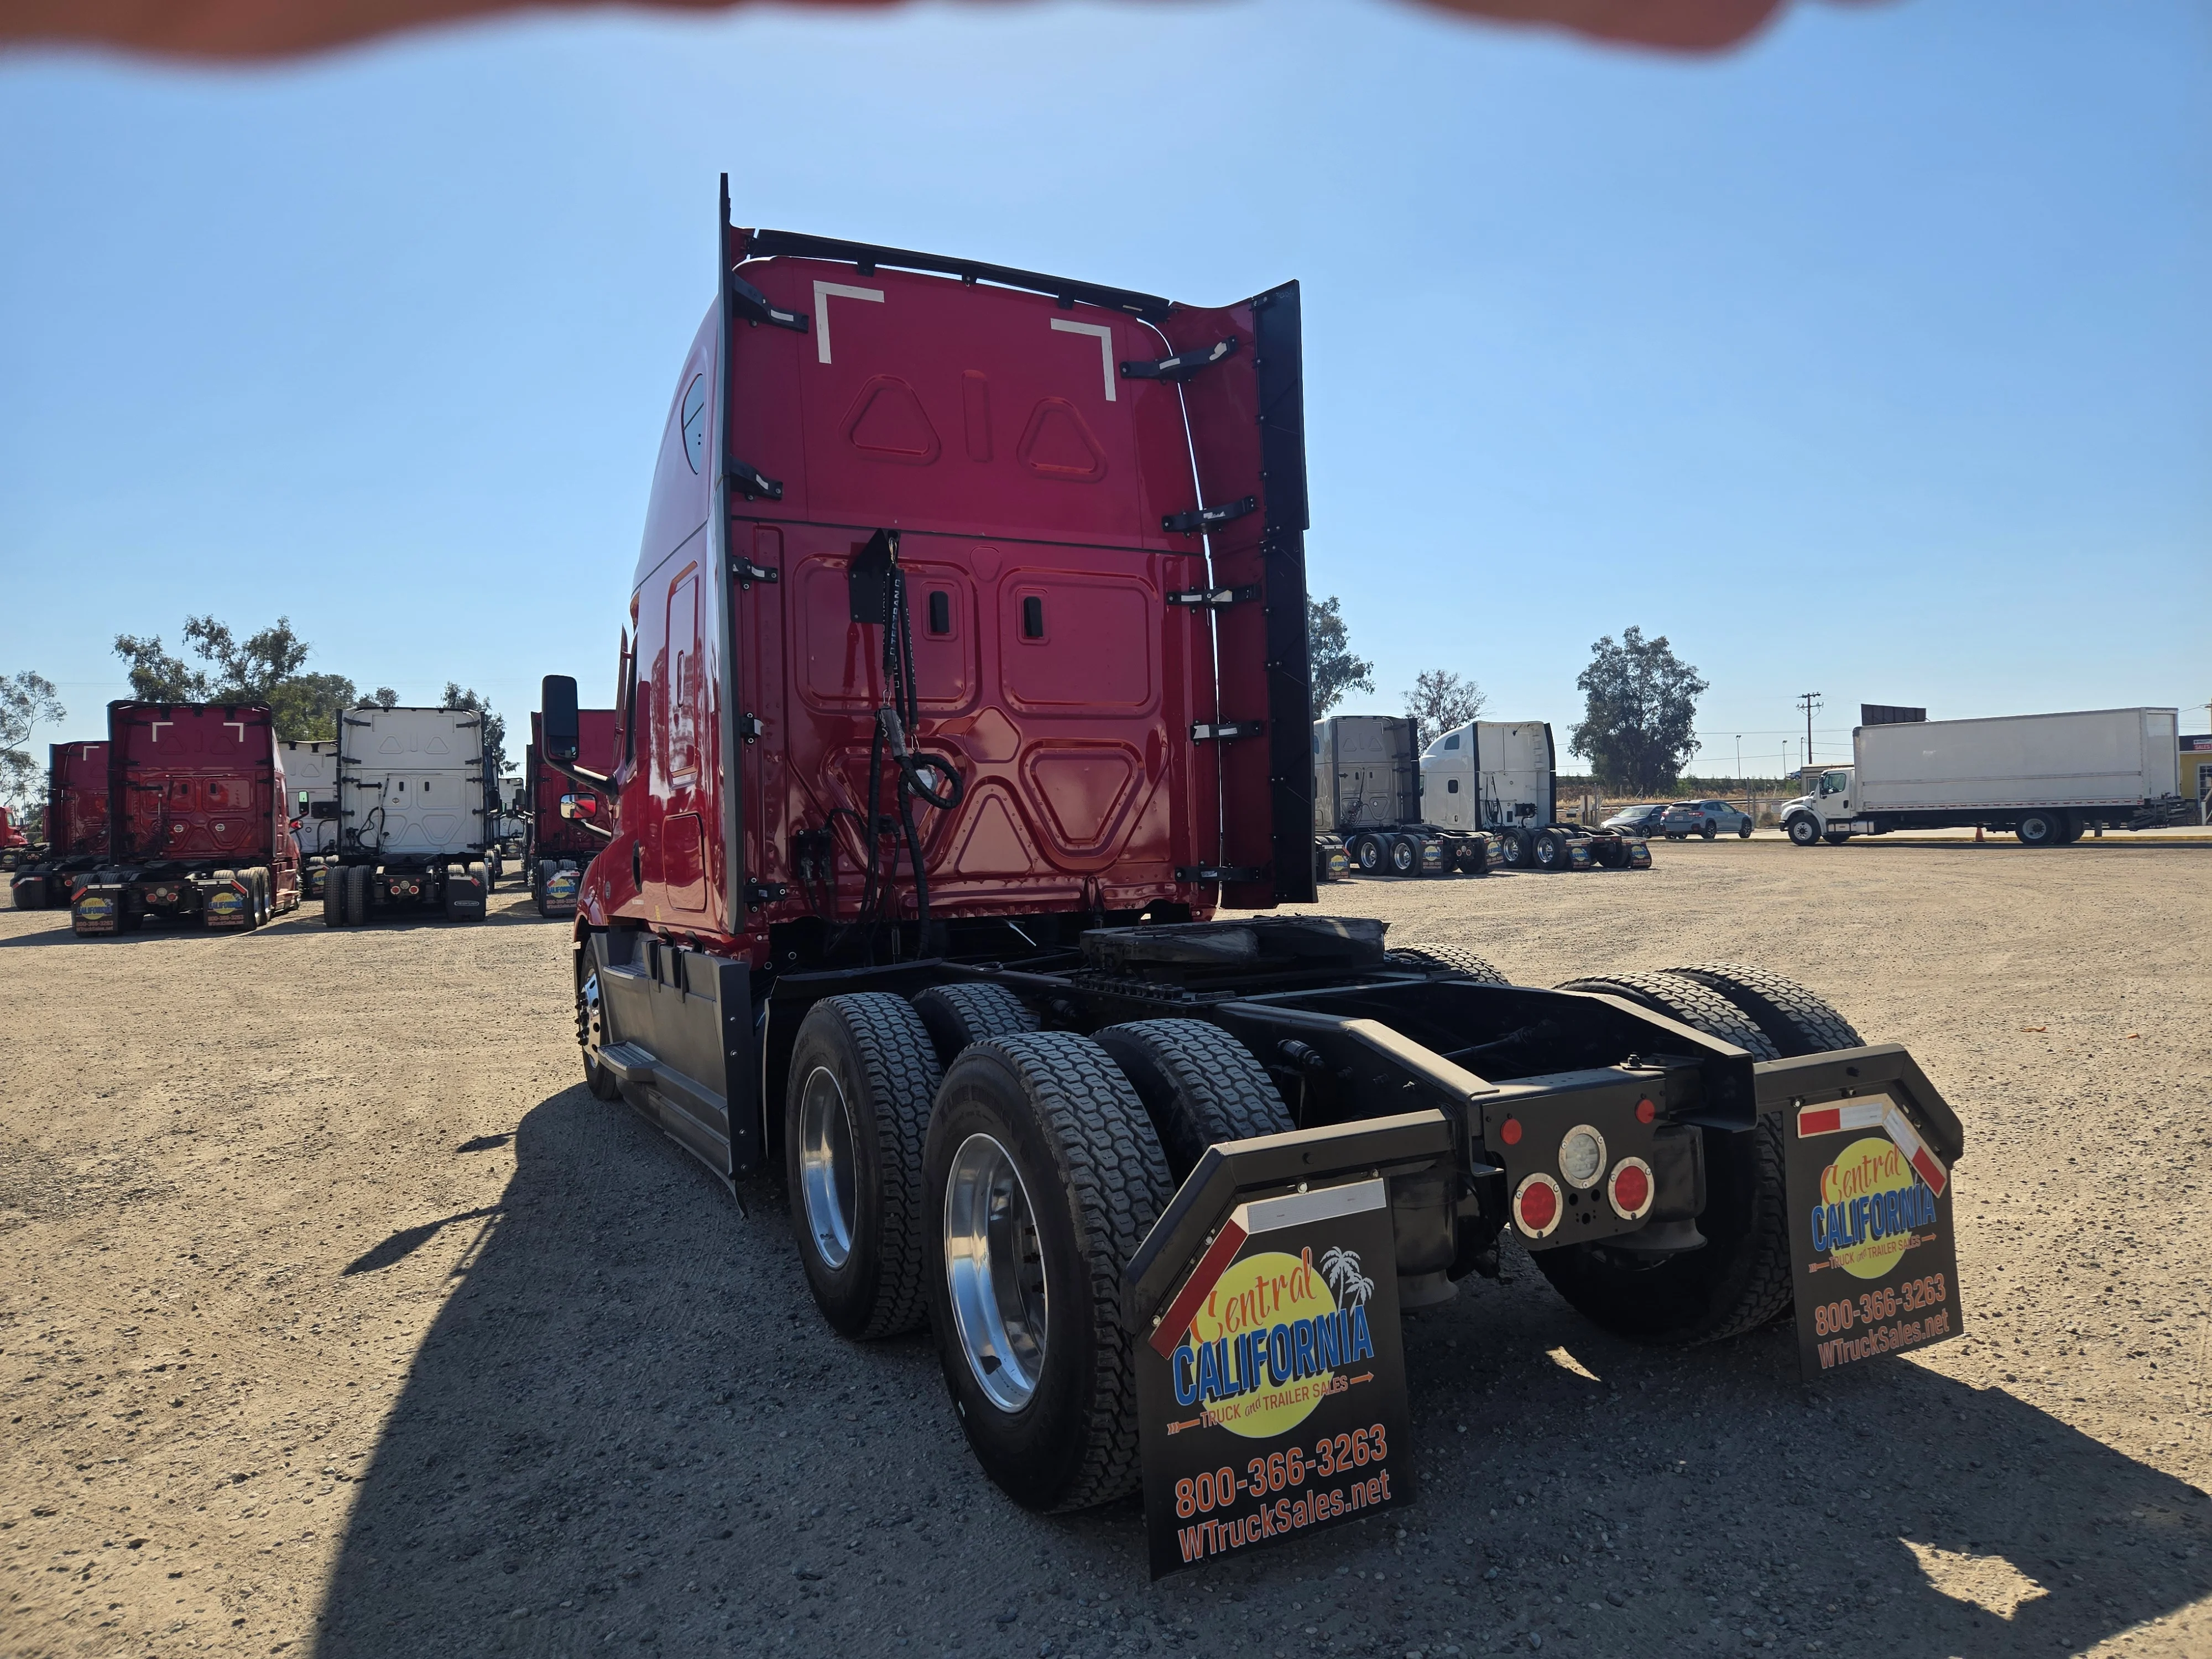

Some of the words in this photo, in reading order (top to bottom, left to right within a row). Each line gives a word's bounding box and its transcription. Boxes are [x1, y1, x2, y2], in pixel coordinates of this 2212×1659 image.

[1820, 1144, 1901, 1205] Central
[1812, 1184, 1937, 1251] CALIFORNIA
[1829, 1254, 1854, 1269] TRUCK
[1856, 1246, 1867, 1262] and
[1867, 1244, 1897, 1258] TRAILER
[1898, 1235, 1921, 1250] SALES
[1190, 1246, 1317, 1346] Central
[1815, 1273, 1946, 1335] 800-366-3263
[1172, 1305, 1374, 1406] CALIFORNIA
[1818, 1308, 1949, 1369] WTruckSales.net
[1200, 1404, 1241, 1428] TRUCK
[1245, 1394, 1261, 1417] and
[1263, 1388, 1309, 1413] TRAILER
[1313, 1375, 1348, 1398] SALES
[1175, 1423, 1388, 1519] 800-366-3263
[1177, 1469, 1391, 1563] WTruckSales.net
